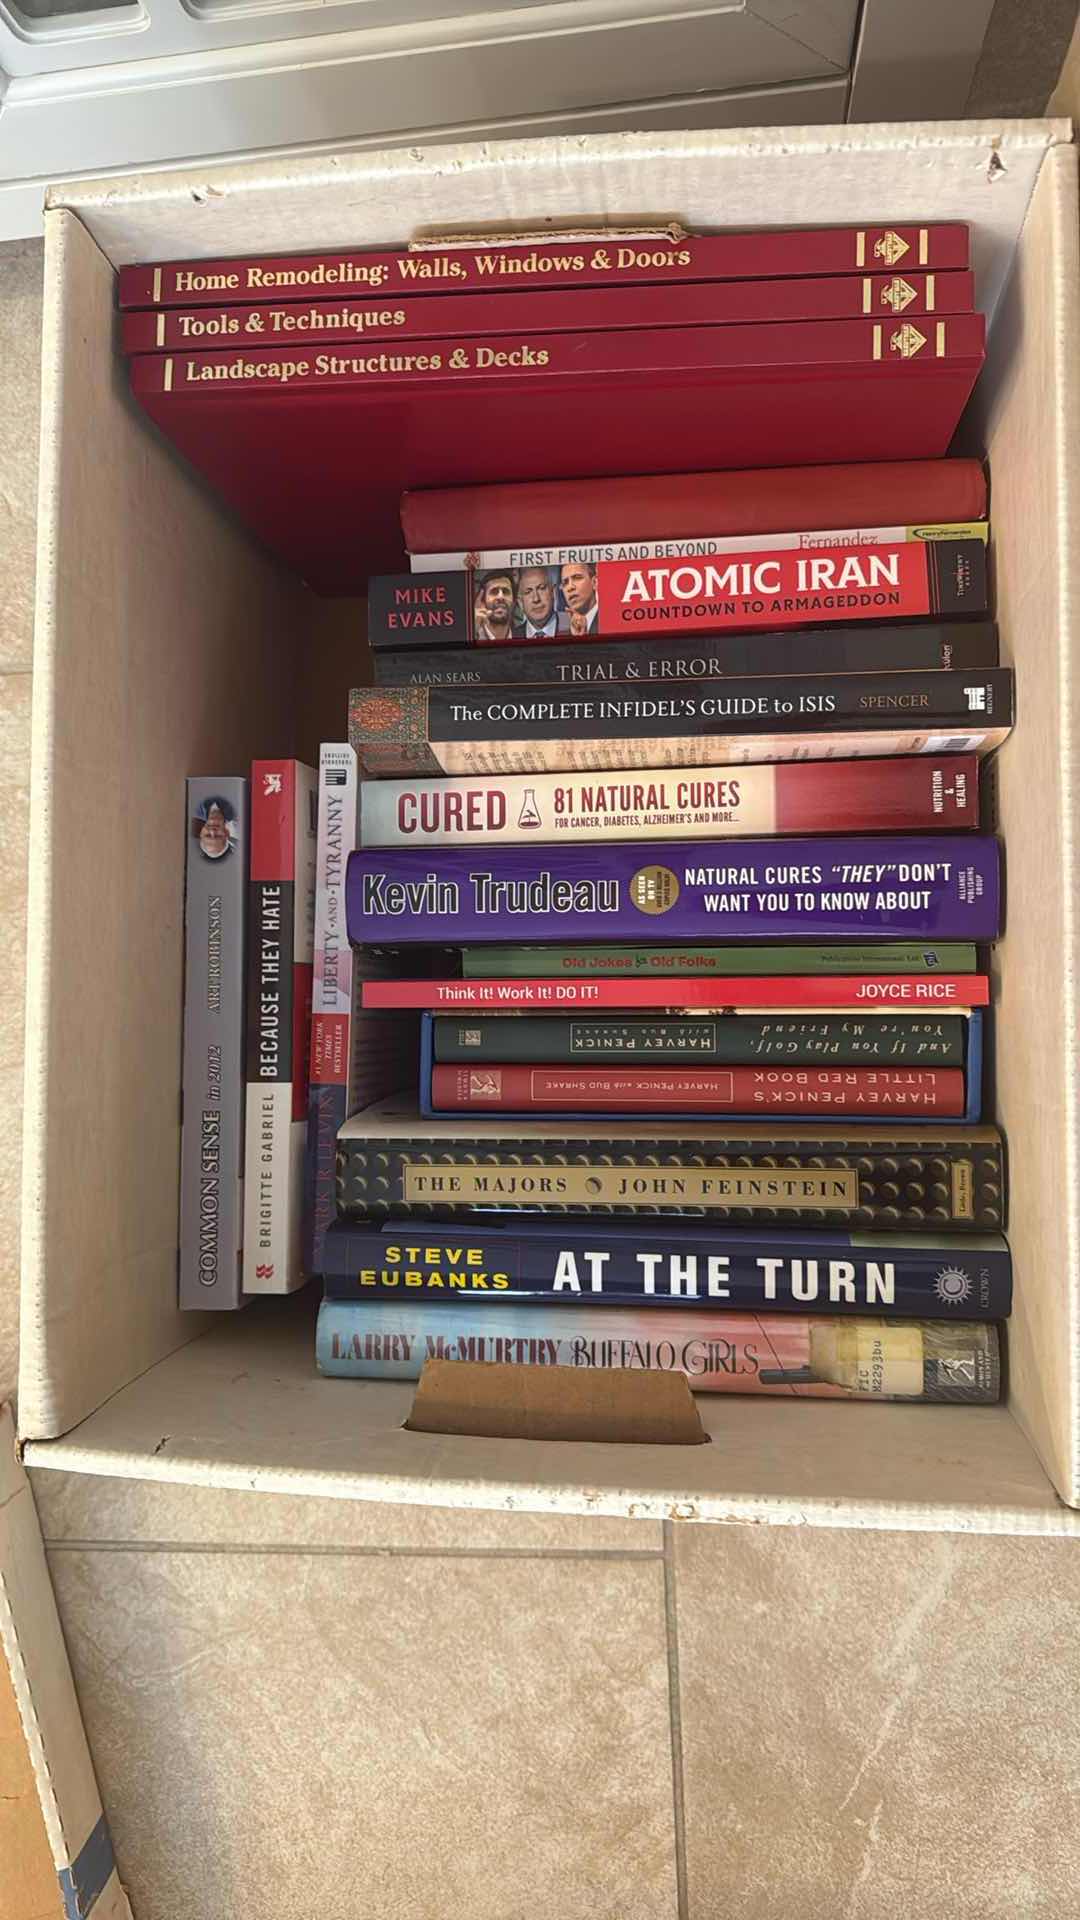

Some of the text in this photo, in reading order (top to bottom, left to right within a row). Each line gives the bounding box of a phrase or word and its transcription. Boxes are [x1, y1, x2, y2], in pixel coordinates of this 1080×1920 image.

[175, 247, 690, 292] Home Remodeling: Walls, Windows & Doors
[179, 308, 406, 337] Tools & Techniques
[186, 346, 549, 382] Landscape Structures & Decks
[799, 533, 879, 549] Fernandez
[509, 541, 717, 567] FIRST FRUITS AND BEYOND
[621, 553, 900, 603] ATOMIC IRAN
[395, 587, 446, 604] MIKE
[622, 592, 900, 621] COUNTDOWN TO ARMAGEDDON
[388, 609, 455, 628] EVANS
[410, 672, 481, 684] ALAN SEARS
[556, 657, 722, 681] TRIAL & ERROR
[450, 695, 836, 721] The COMPLETE INFIDEL'S GUIDE to ISIS
[860, 694, 929, 709] SPENCER
[553, 780, 740, 814] 81 NATURAL CURES
[932, 770, 943, 813] NUTRITION
[945, 786, 954, 794] &
[956, 773, 967, 808] HEALING
[397, 791, 507, 834] CURED
[554, 817, 568, 829] FOR
[570, 815, 602, 829] CANCER,
[603, 814, 641, 828] DIABETES,
[643, 812, 692, 826] ALZHEIMER'S
[694, 813, 709, 823] AND
[326, 795, 343, 889] TYRANNY
[685, 868, 759, 885] NATURAL
[765, 866, 822, 884] CURES
[976, 874, 984, 896] GROUP
[362, 873, 459, 915] Kevin
[469, 872, 619, 913] Trudeau
[704, 891, 931, 912] WANT YOU TO KNOW ABOUT
[207, 896, 222, 1014] ART ROBINSON
[562, 957, 587, 968] Old
[589, 957, 633, 968] Jokes
[650, 957, 673, 968] Old
[678, 956, 716, 967] Folks
[323, 932, 339, 1006] LIBERTY
[260, 886, 280, 1077] BECAUSE THEY HATE
[437, 985, 599, 1000] Think It! Work It! DO IT!
[856, 983, 956, 998] JOYCE RICE
[761, 1024, 943, 1035] You're My Friend
[575, 1038, 711, 1049] HARVEY PENICK
[750, 1041, 952, 1054] And If You Play Golf,
[636, 1082, 674, 1090] PENICK
[679, 1082, 718, 1090] HARVEY
[754, 1072, 936, 1085] LITTLE RED BOOK
[754, 1091, 936, 1105] HARVEY PENICK'S
[318, 1094, 335, 1155] LEVIN
[200, 1045, 221, 1288] COMMON SENSE in 2012
[260, 1094, 274, 1248] BRIGITTE GABRIEL
[415, 1176, 567, 1193] THE MAJORS
[619, 1178, 847, 1197] JOHN FEINSTEIN
[385, 1247, 483, 1266] STEVE
[360, 1270, 509, 1290] EUBANKS
[553, 1251, 895, 1305] AT THE TURN
[331, 1333, 415, 1361] LARRY
[570, 1335, 759, 1375] BUFFALO GIRLS
[859, 1370, 869, 1392] FIC
